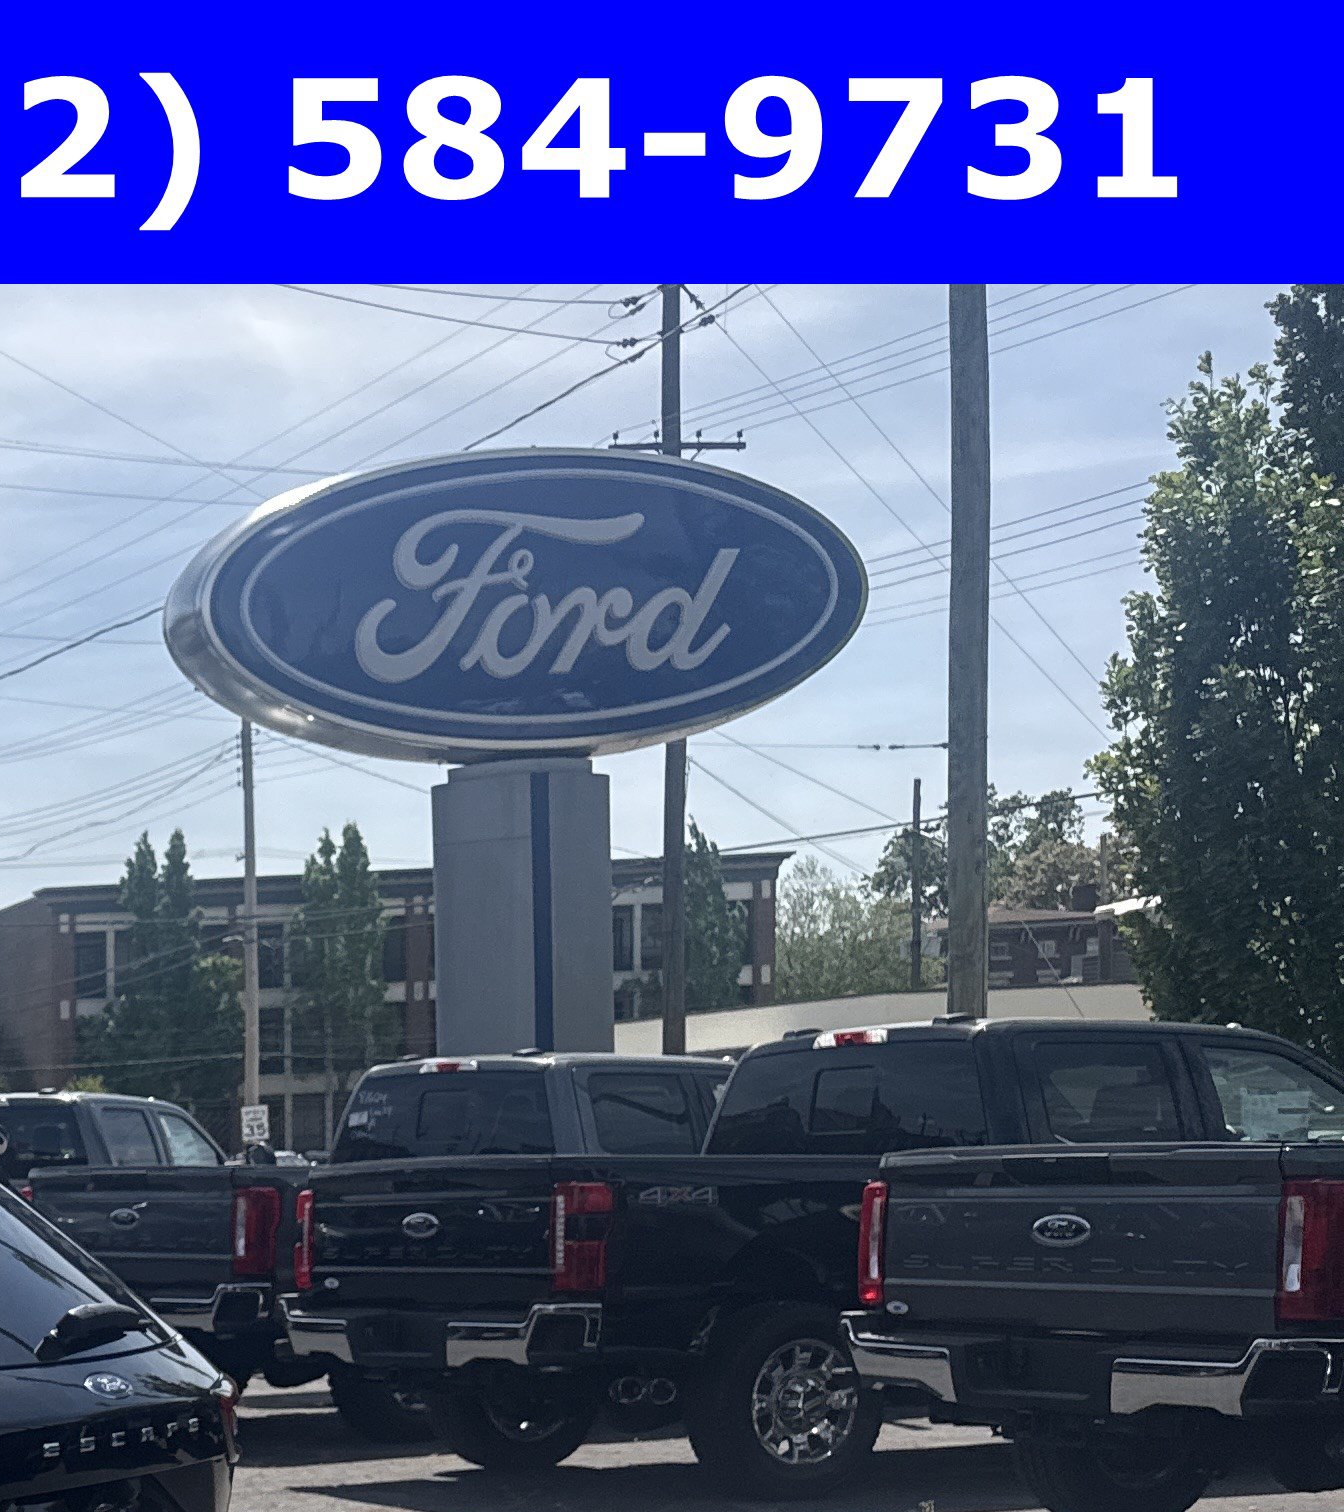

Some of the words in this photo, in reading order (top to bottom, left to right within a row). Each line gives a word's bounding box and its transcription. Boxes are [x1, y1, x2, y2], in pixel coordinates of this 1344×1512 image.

[354, 509, 741, 683] Ford
[902, 1254, 1074, 1273] SUPER
[1088, 1257, 1249, 1277] DUTY
[42, 1416, 200, 1458] ESCAPE
